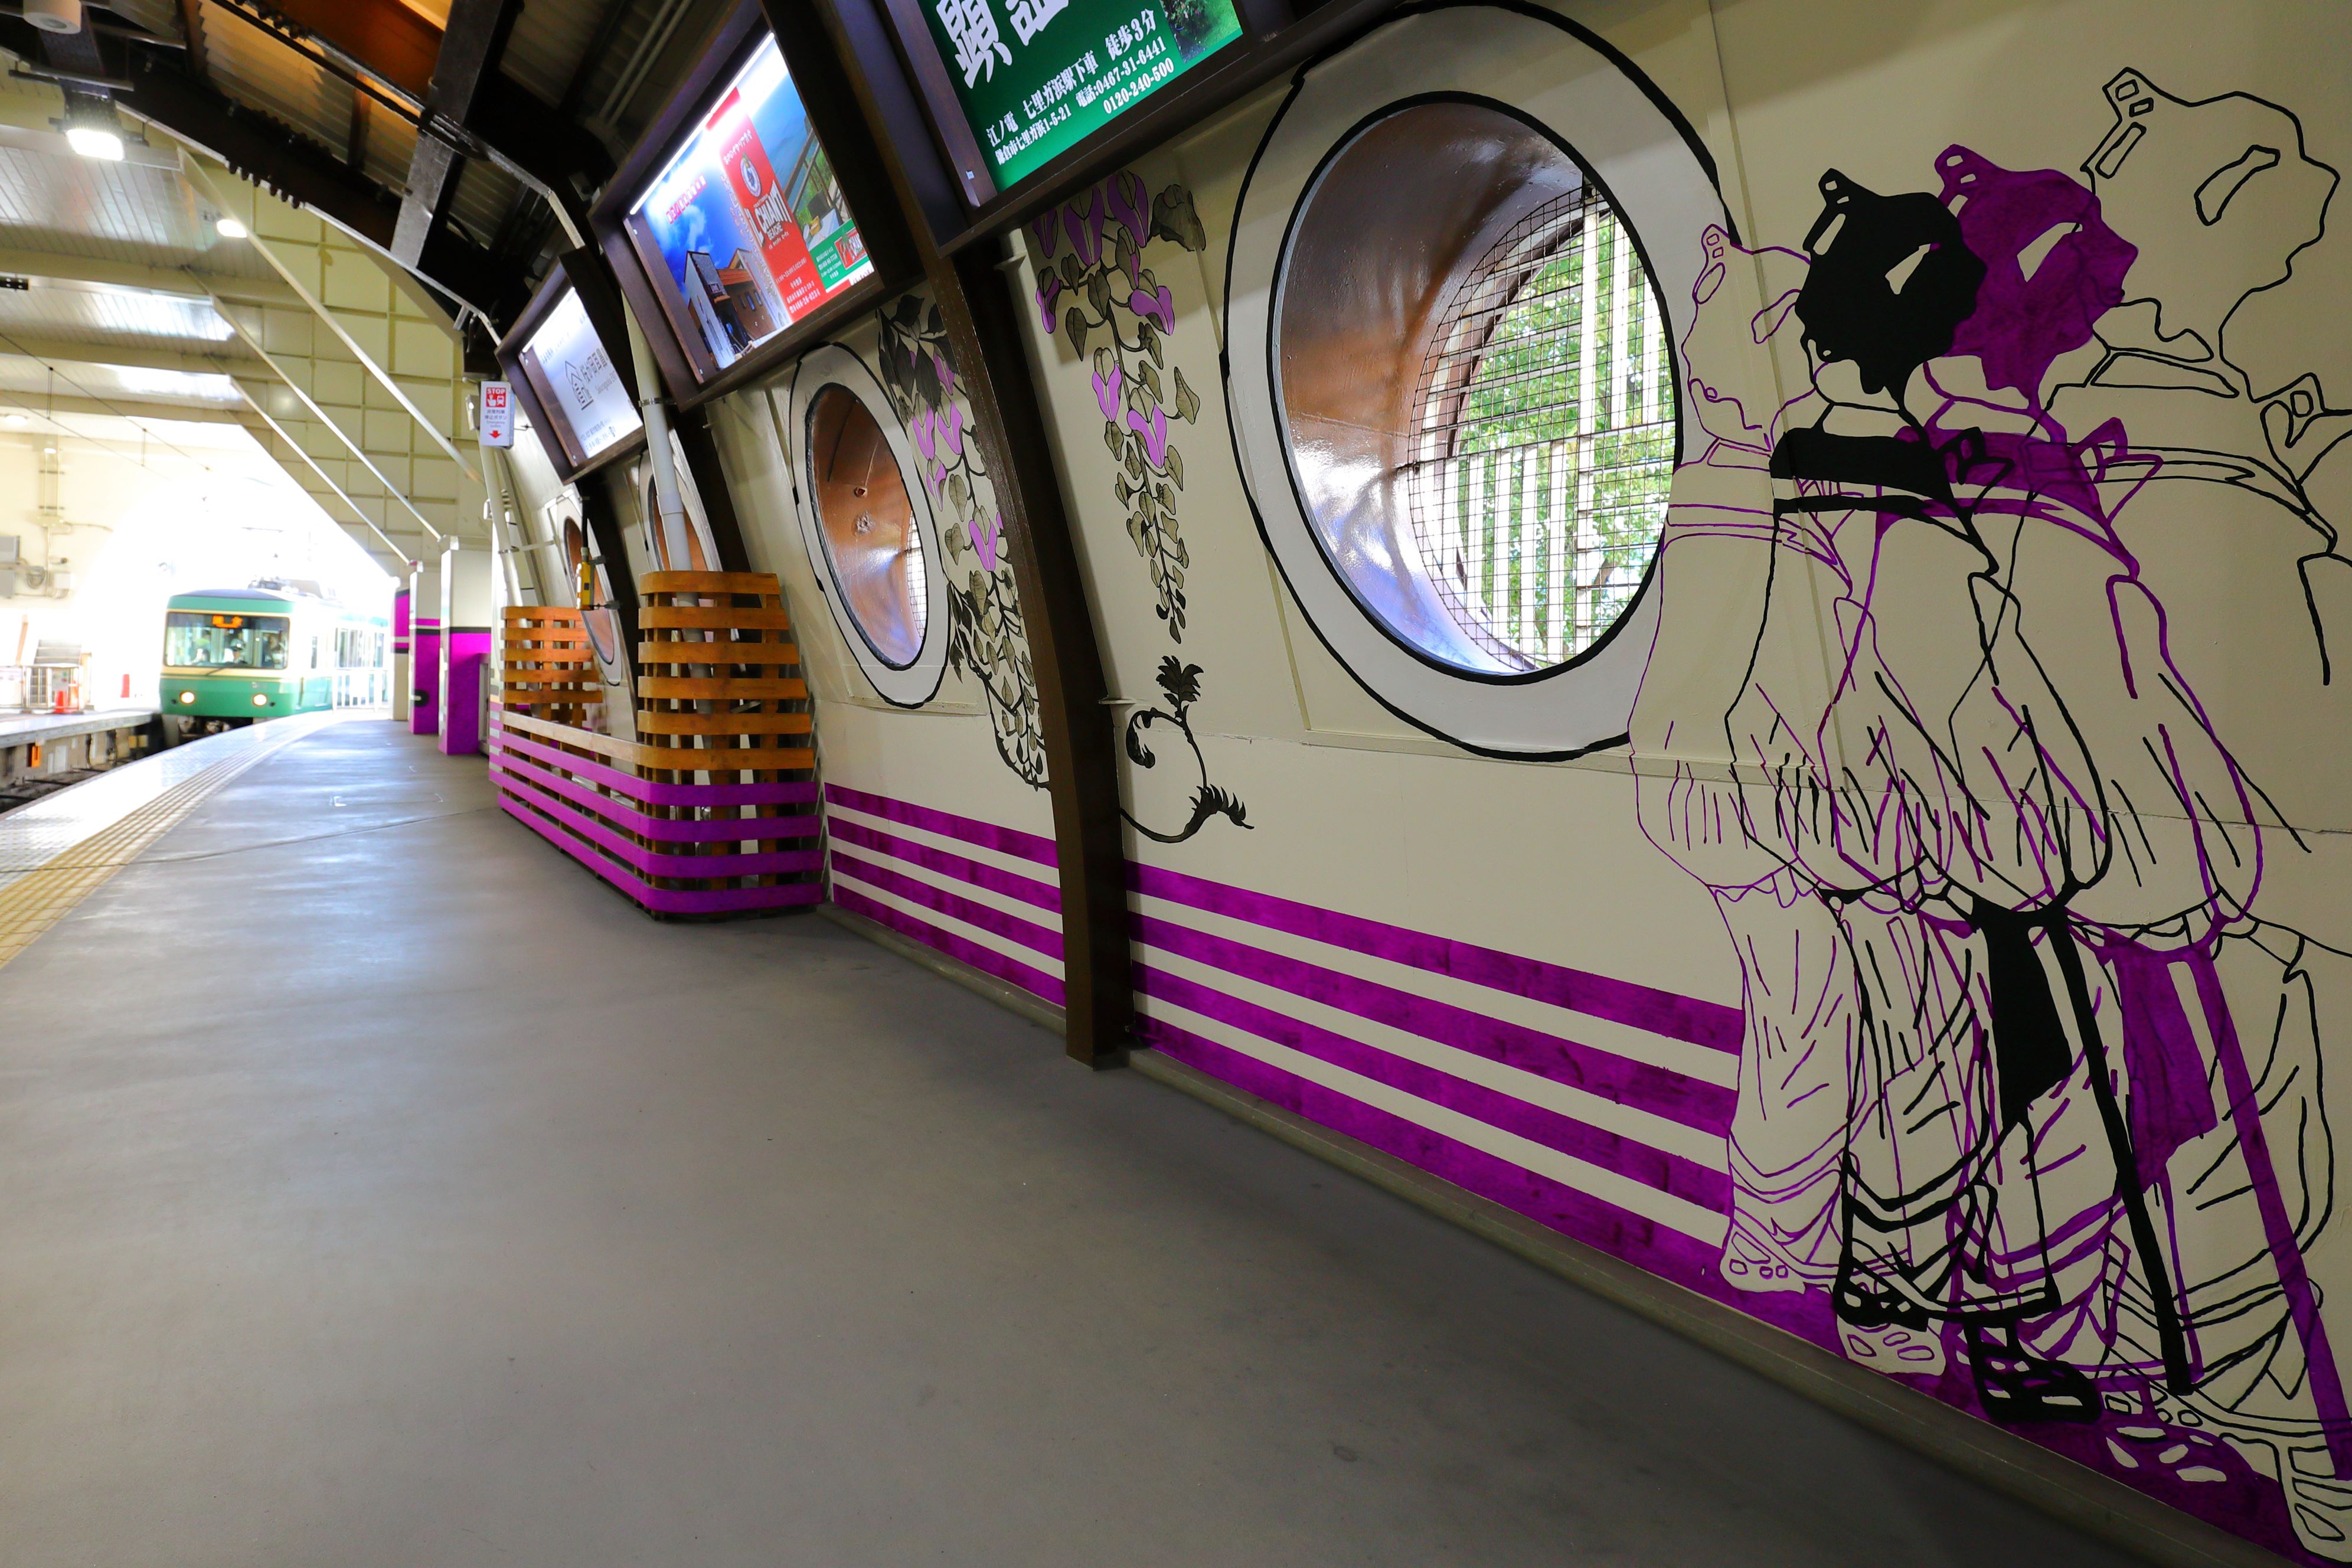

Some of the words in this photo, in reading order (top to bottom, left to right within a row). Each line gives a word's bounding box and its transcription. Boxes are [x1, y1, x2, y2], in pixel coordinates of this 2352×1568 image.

[986, 110, 1019, 147] 江ノ電
[1023, 50, 1099, 120] 七里ガ浜駅下車
[1105, 8, 1157, 61] 徒歩3分
[1103, 57, 1174, 115] 0120-240-500
[995, 103, 1072, 166] 鎌倉市七里ガ浜1-5-21
[754, 179, 792, 234] CHIANTI
